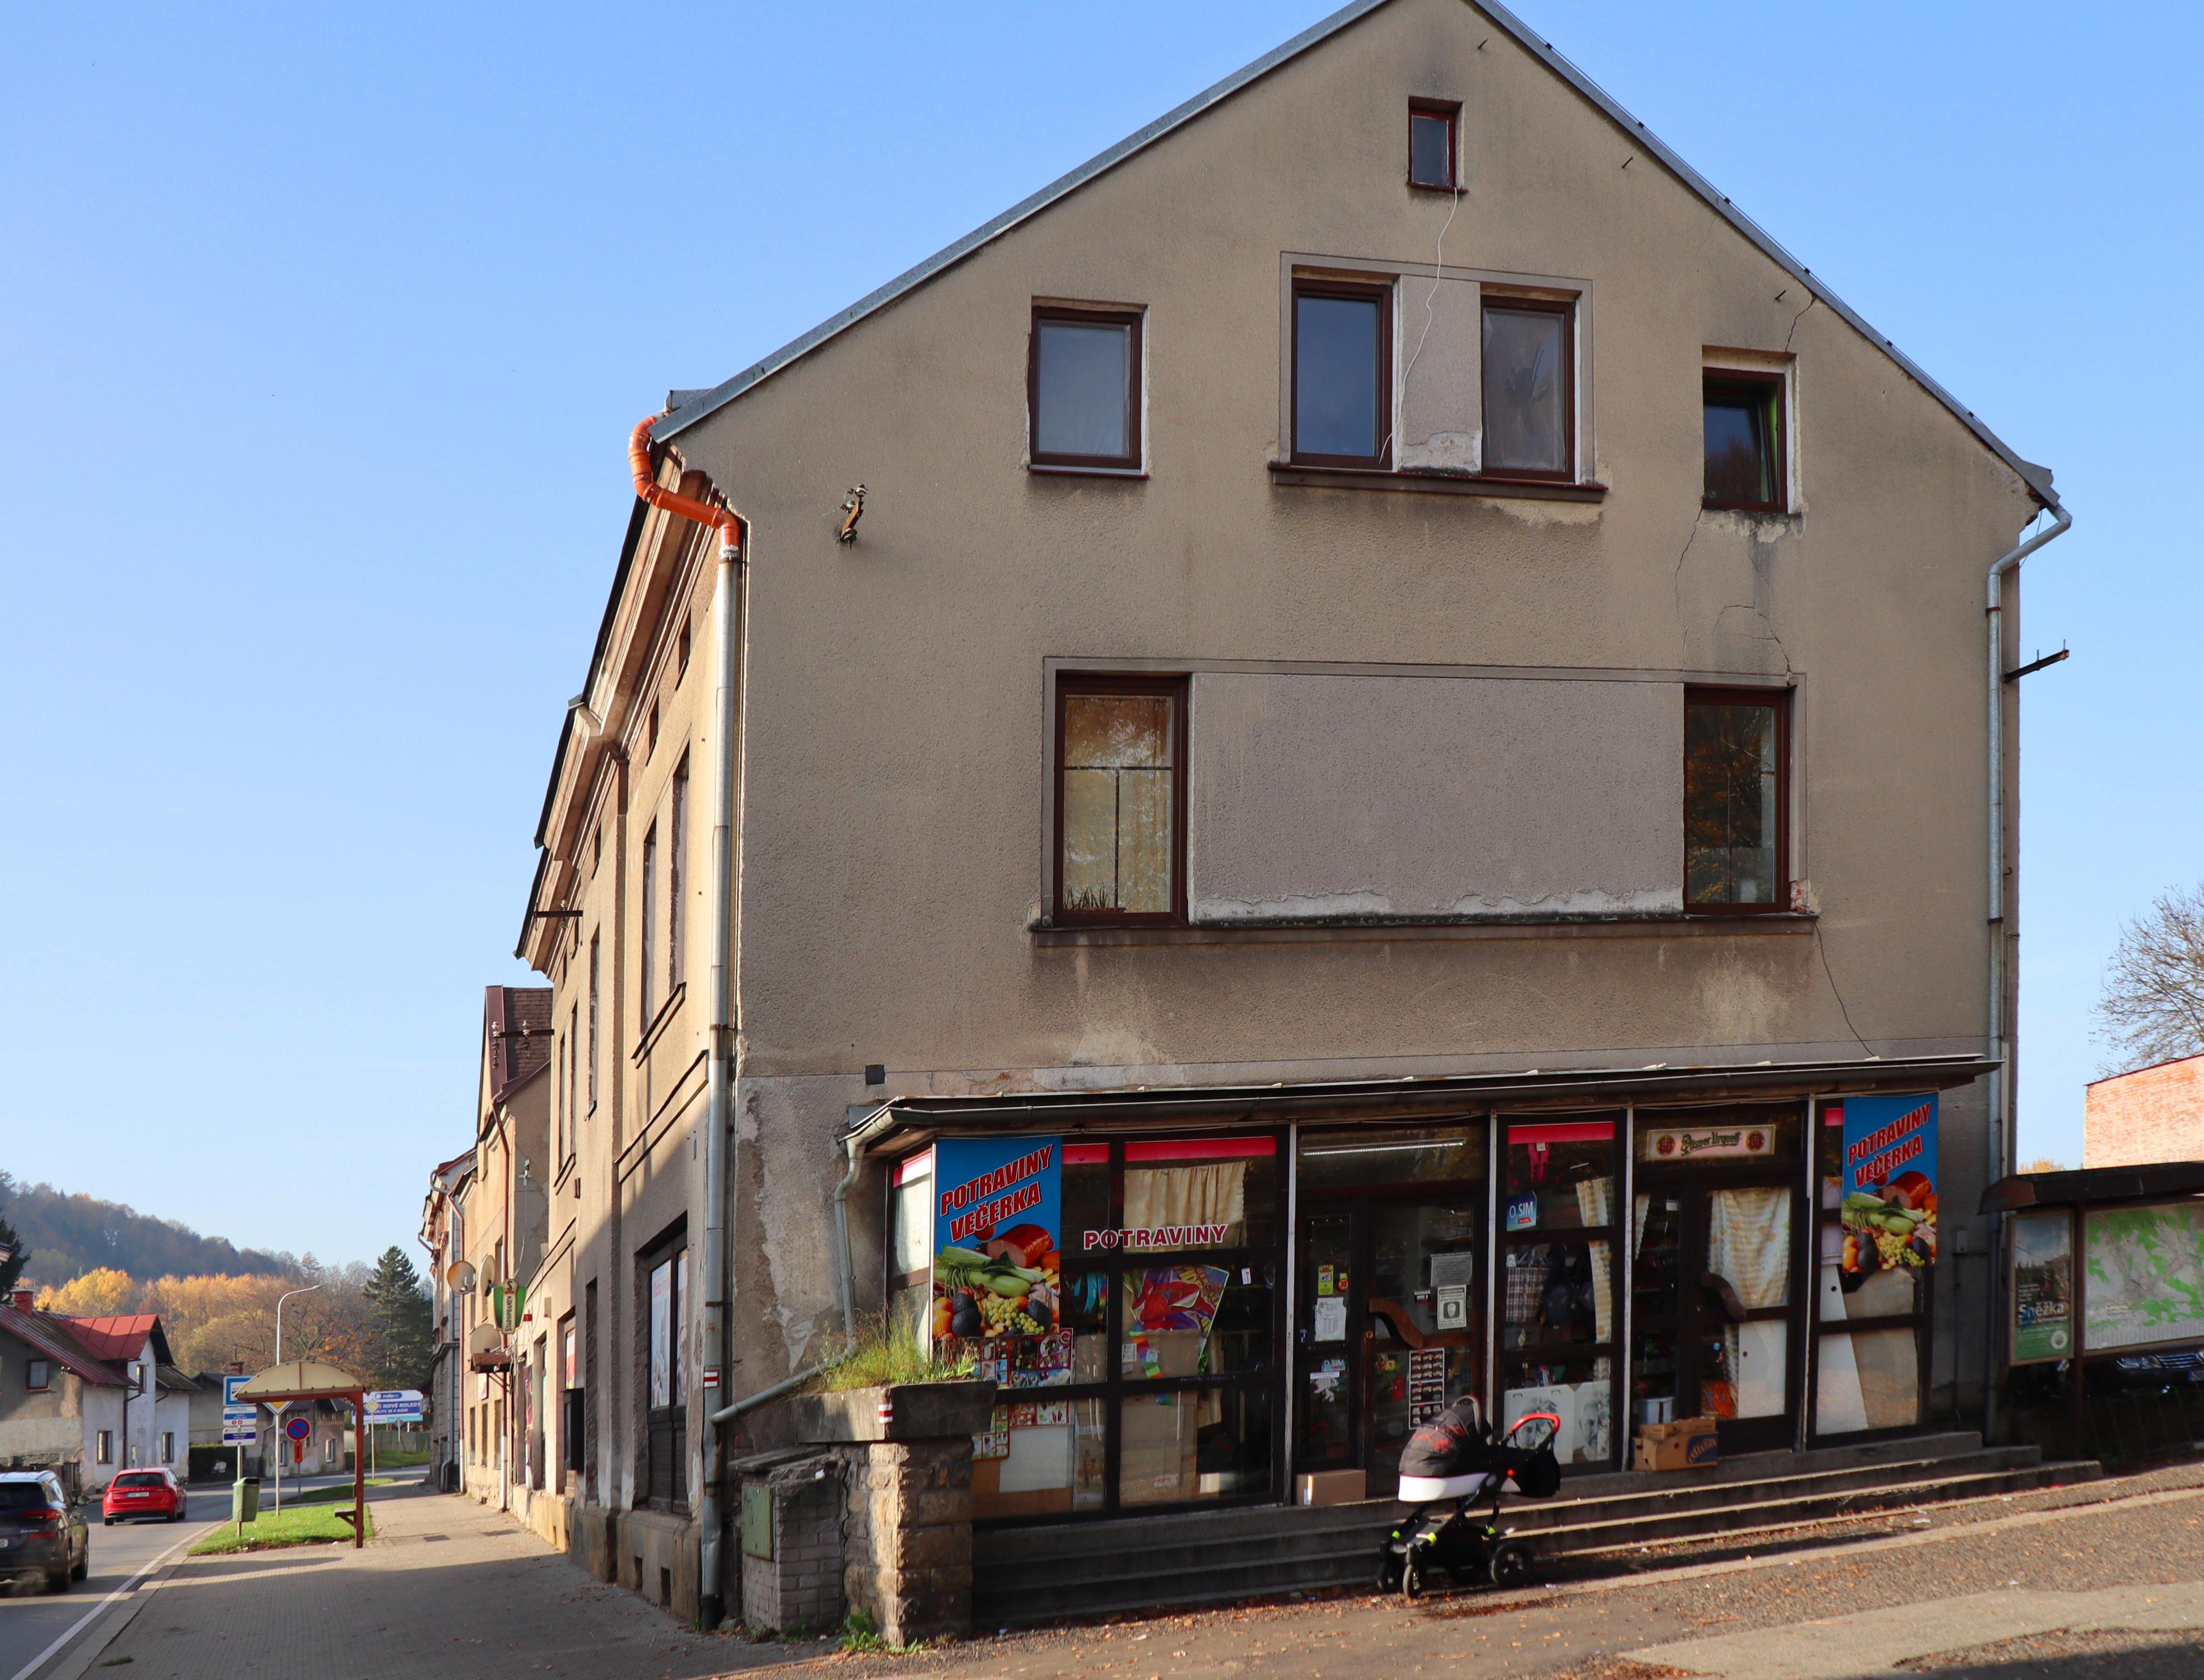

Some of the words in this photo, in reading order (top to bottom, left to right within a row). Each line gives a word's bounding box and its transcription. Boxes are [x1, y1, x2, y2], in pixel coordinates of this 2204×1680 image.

[1681, 1133, 1711, 1156] Pilsner
[1848, 1102, 1932, 1166] POTRAVINY
[940, 1144, 1053, 1216] POTRAVINY
[1855, 1134, 1924, 1188] VEČERKA
[950, 1182, 1042, 1242] VEČERKA
[1519, 1201, 1533, 1217] SIM
[1084, 1224, 1228, 1250] POTRAVINY
[2018, 1300, 2065, 1318] Sněžka
